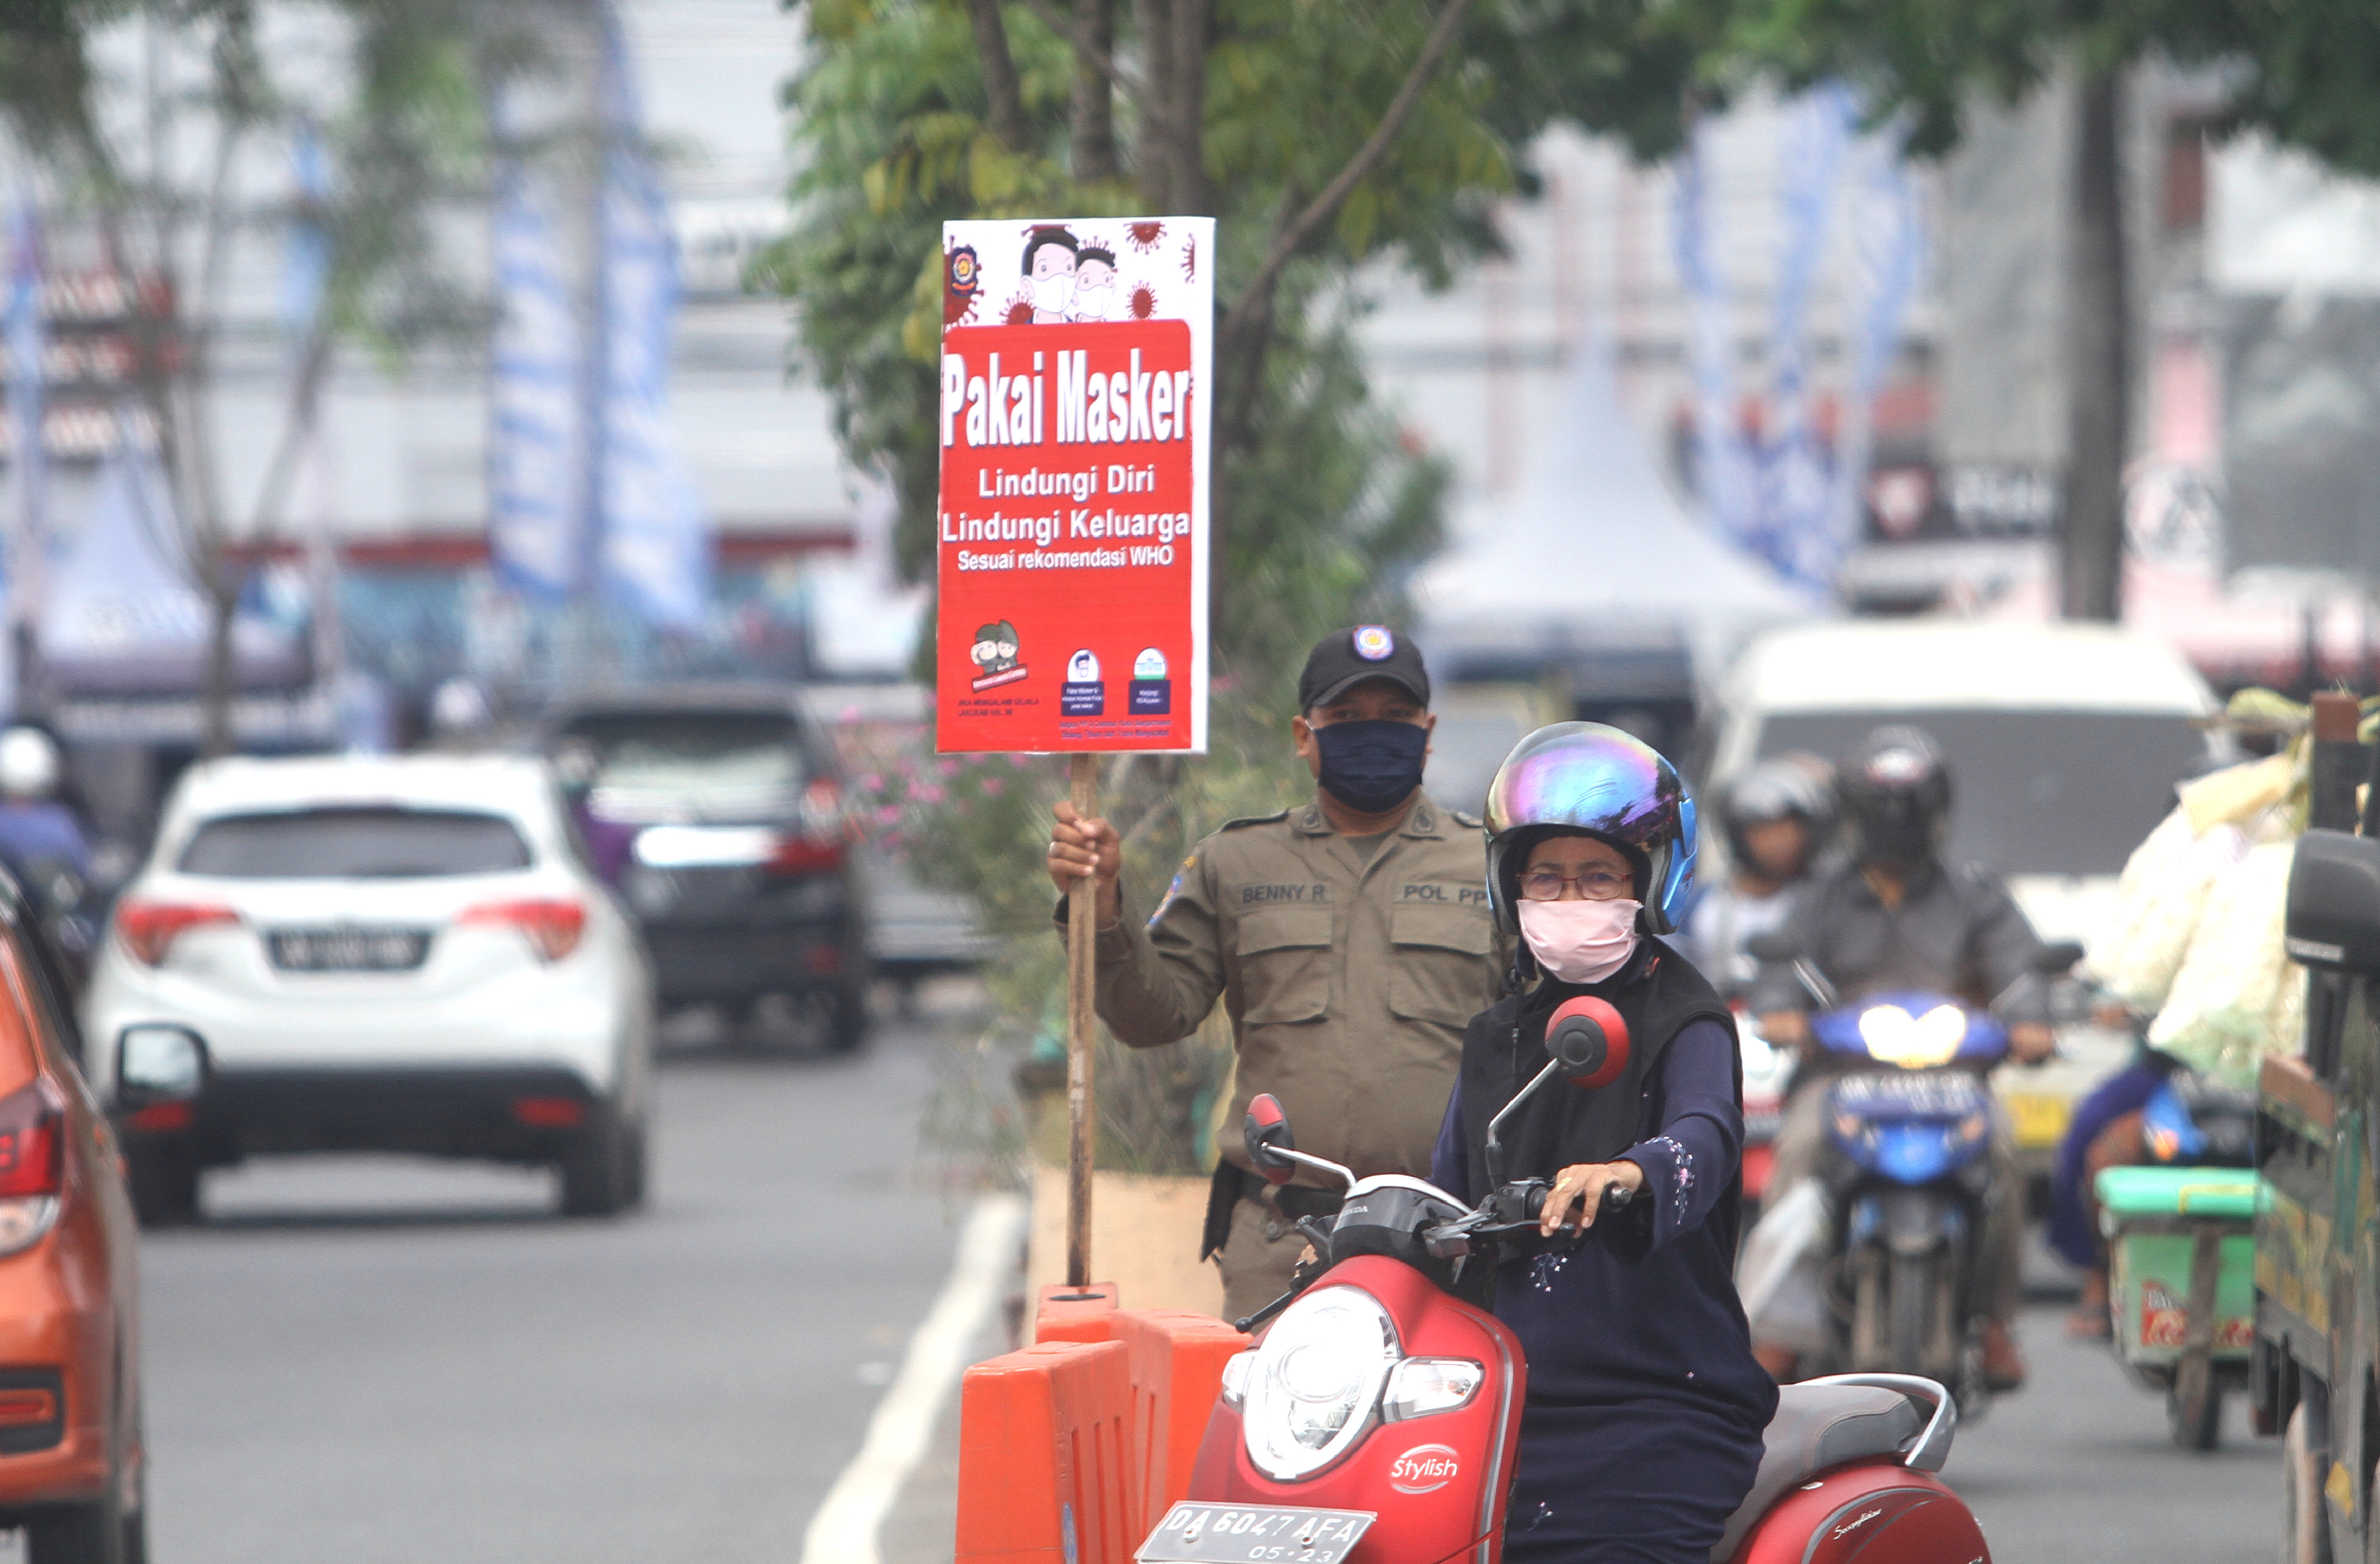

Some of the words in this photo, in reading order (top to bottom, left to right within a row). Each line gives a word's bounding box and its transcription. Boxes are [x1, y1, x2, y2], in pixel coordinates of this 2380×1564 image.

[942, 351, 1045, 448] Pakai
[1056, 348, 1191, 445] Masker
[978, 466, 1097, 502] Lindungi
[1107, 464, 1155, 493] Diri
[942, 510, 1061, 546] Lindungi
[1070, 508, 1190, 543] Keluarga
[957, 549, 1015, 571] Sesuai
[1017, 546, 1126, 569] rekomendasi
[1130, 545, 1174, 566] WHO
[1242, 883, 1305, 904] BENNY
[1311, 883, 1327, 901] R
[1403, 884, 1448, 901] POL
[1458, 888, 1487, 907] PP
[1391, 1458, 1458, 1480] Stylish
[1166, 1509, 1211, 1532] DA
[1213, 1511, 1295, 1537] 6047
[1292, 1516, 1357, 1543] AFA
